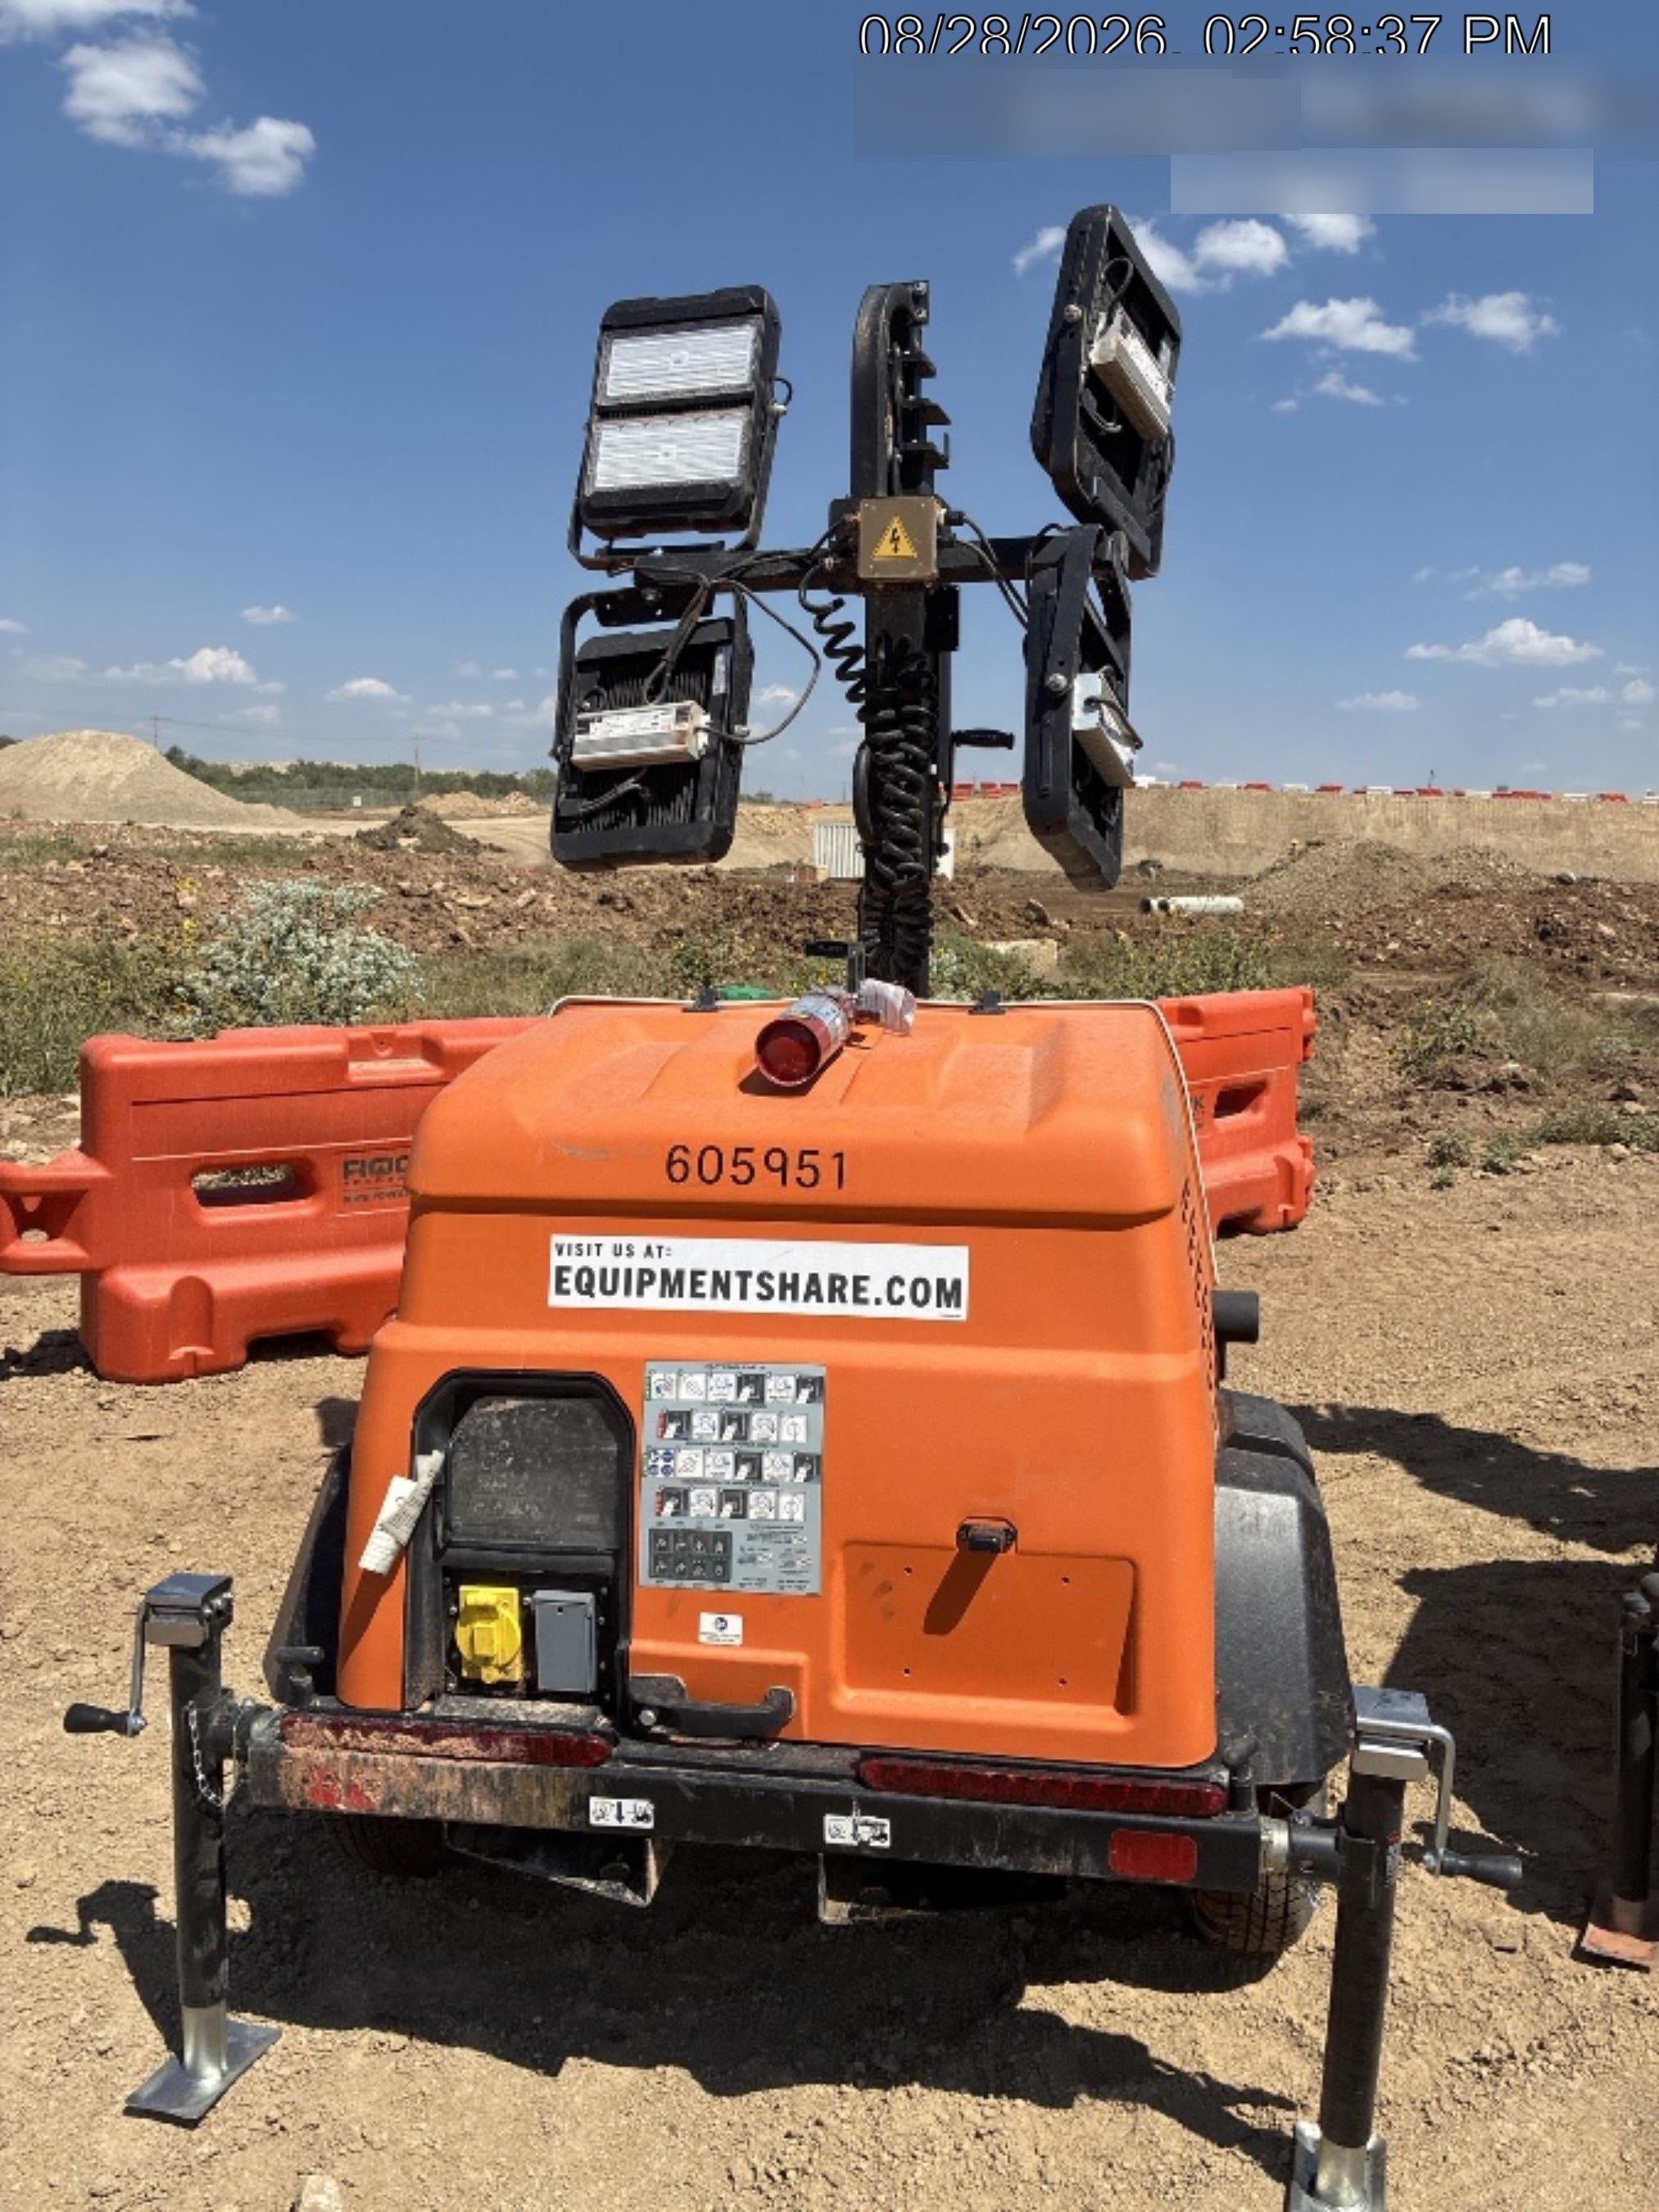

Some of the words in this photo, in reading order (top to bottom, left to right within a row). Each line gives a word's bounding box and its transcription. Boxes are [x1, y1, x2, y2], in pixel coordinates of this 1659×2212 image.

[665, 1145, 846, 1190] 605951
[555, 1243, 603, 1258] VISIT
[612, 1244, 635, 1258] US
[643, 1244, 672, 1259] AT:
[554, 1265, 963, 1308] EQUIPMENTSHARE.COM
